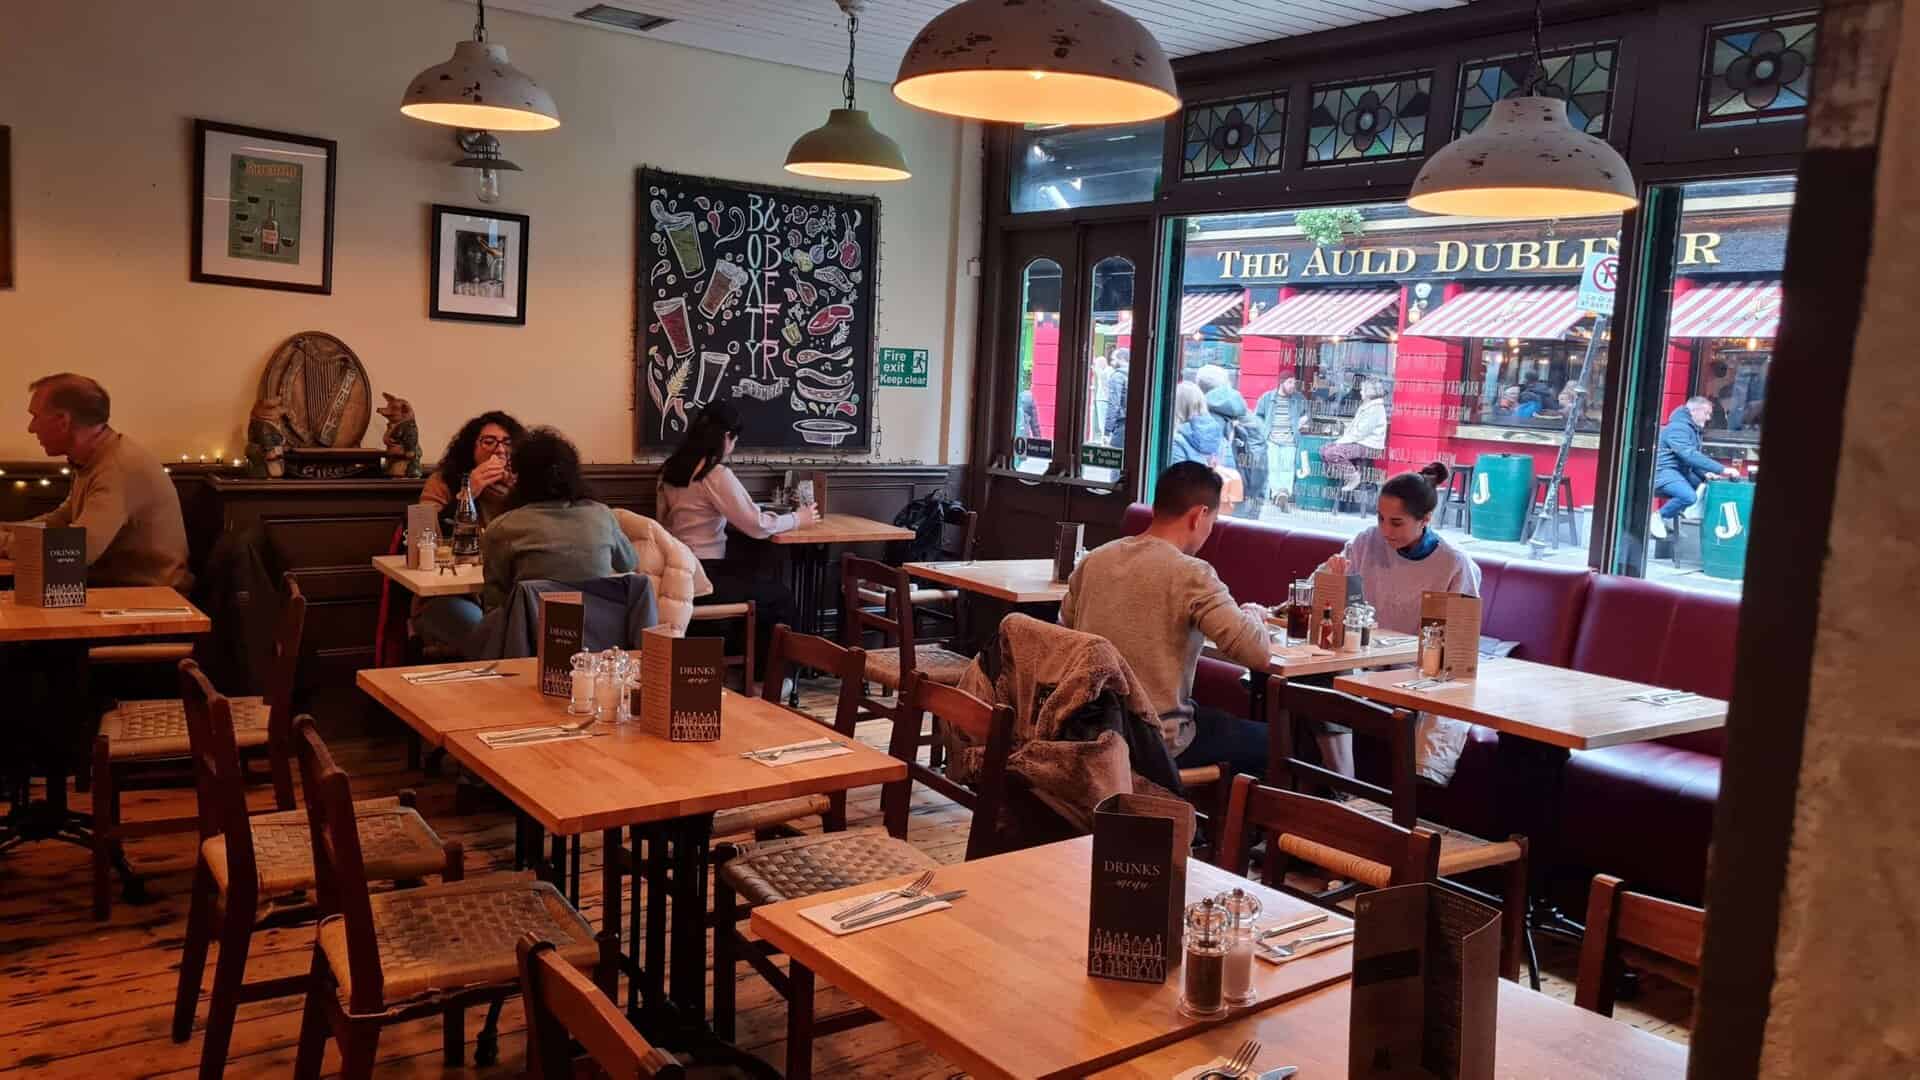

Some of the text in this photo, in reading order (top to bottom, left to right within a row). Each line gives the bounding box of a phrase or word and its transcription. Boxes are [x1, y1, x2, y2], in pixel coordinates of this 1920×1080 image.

[1217, 249, 1290, 279] THE
[1301, 246, 1418, 277] AULD
[745, 194, 764, 378] BOXTY
[763, 198, 783, 380] & BEER
[883, 361, 905, 373] exit
[884, 350, 906, 361] Fire
[880, 375, 928, 386] Keep clear
[1296, 449, 1311, 480] J
[1472, 472, 1491, 504] J
[1714, 501, 1744, 540] J
[679, 665, 716, 676] DRINKS
[1104, 860, 1160, 876] DRINKS
